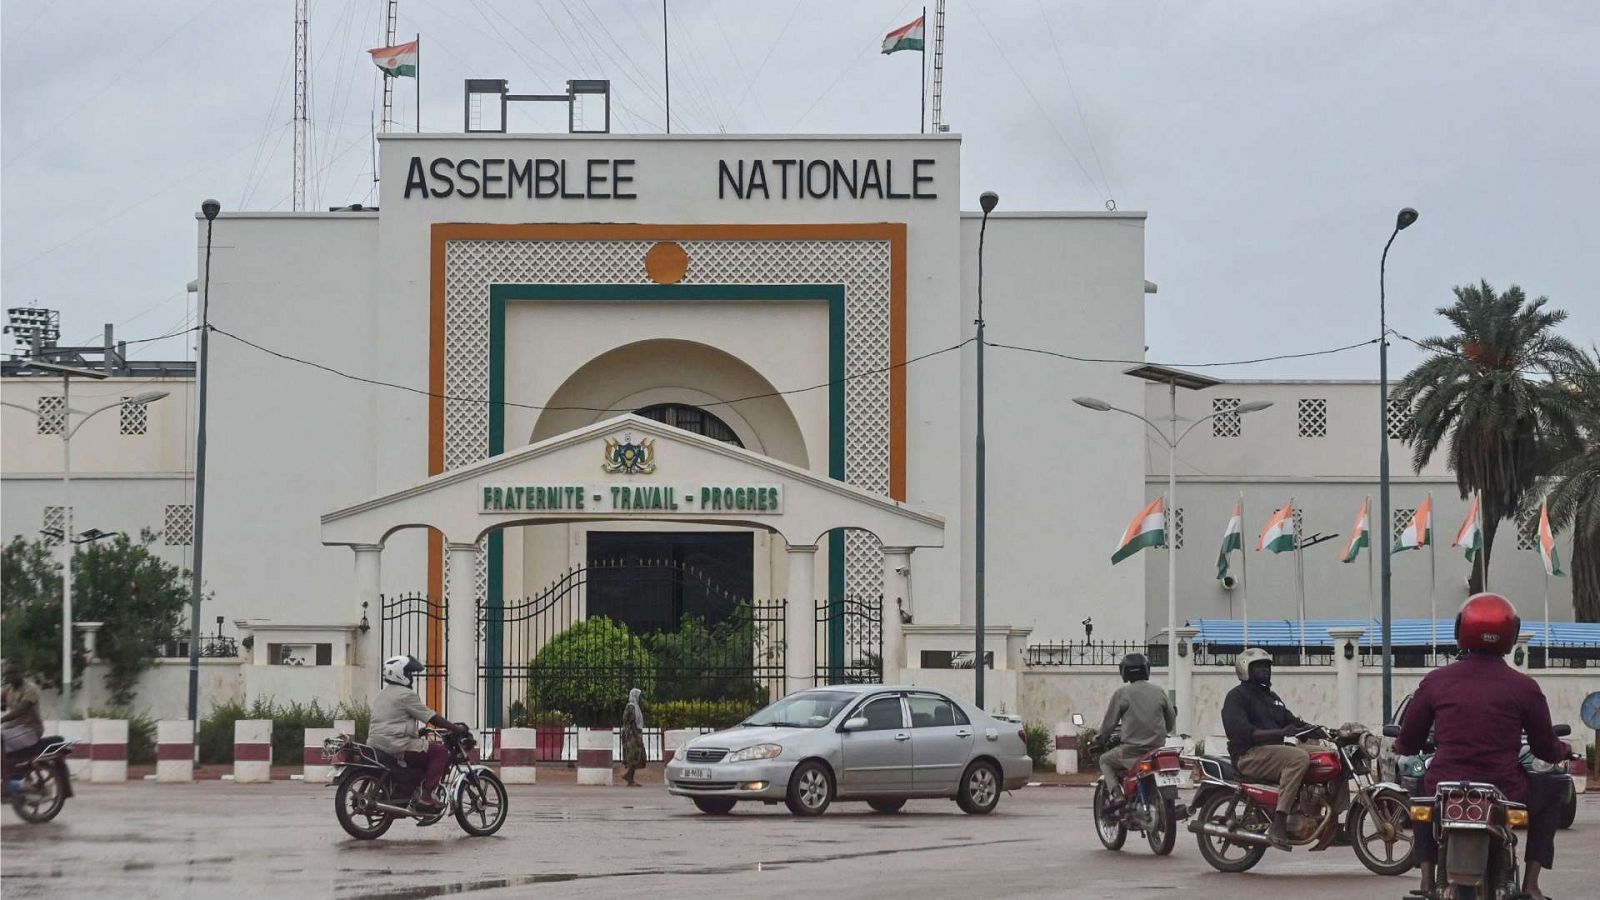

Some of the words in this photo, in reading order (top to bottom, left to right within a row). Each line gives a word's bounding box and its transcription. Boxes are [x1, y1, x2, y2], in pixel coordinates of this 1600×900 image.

[404, 156, 637, 200] ASSEMBLEE
[718, 159, 938, 200] NATIONALE
[484, 486, 585, 510] FRATERNITE
[610, 486, 678, 510] TRAVAIL
[700, 486, 778, 510] PROGRES
